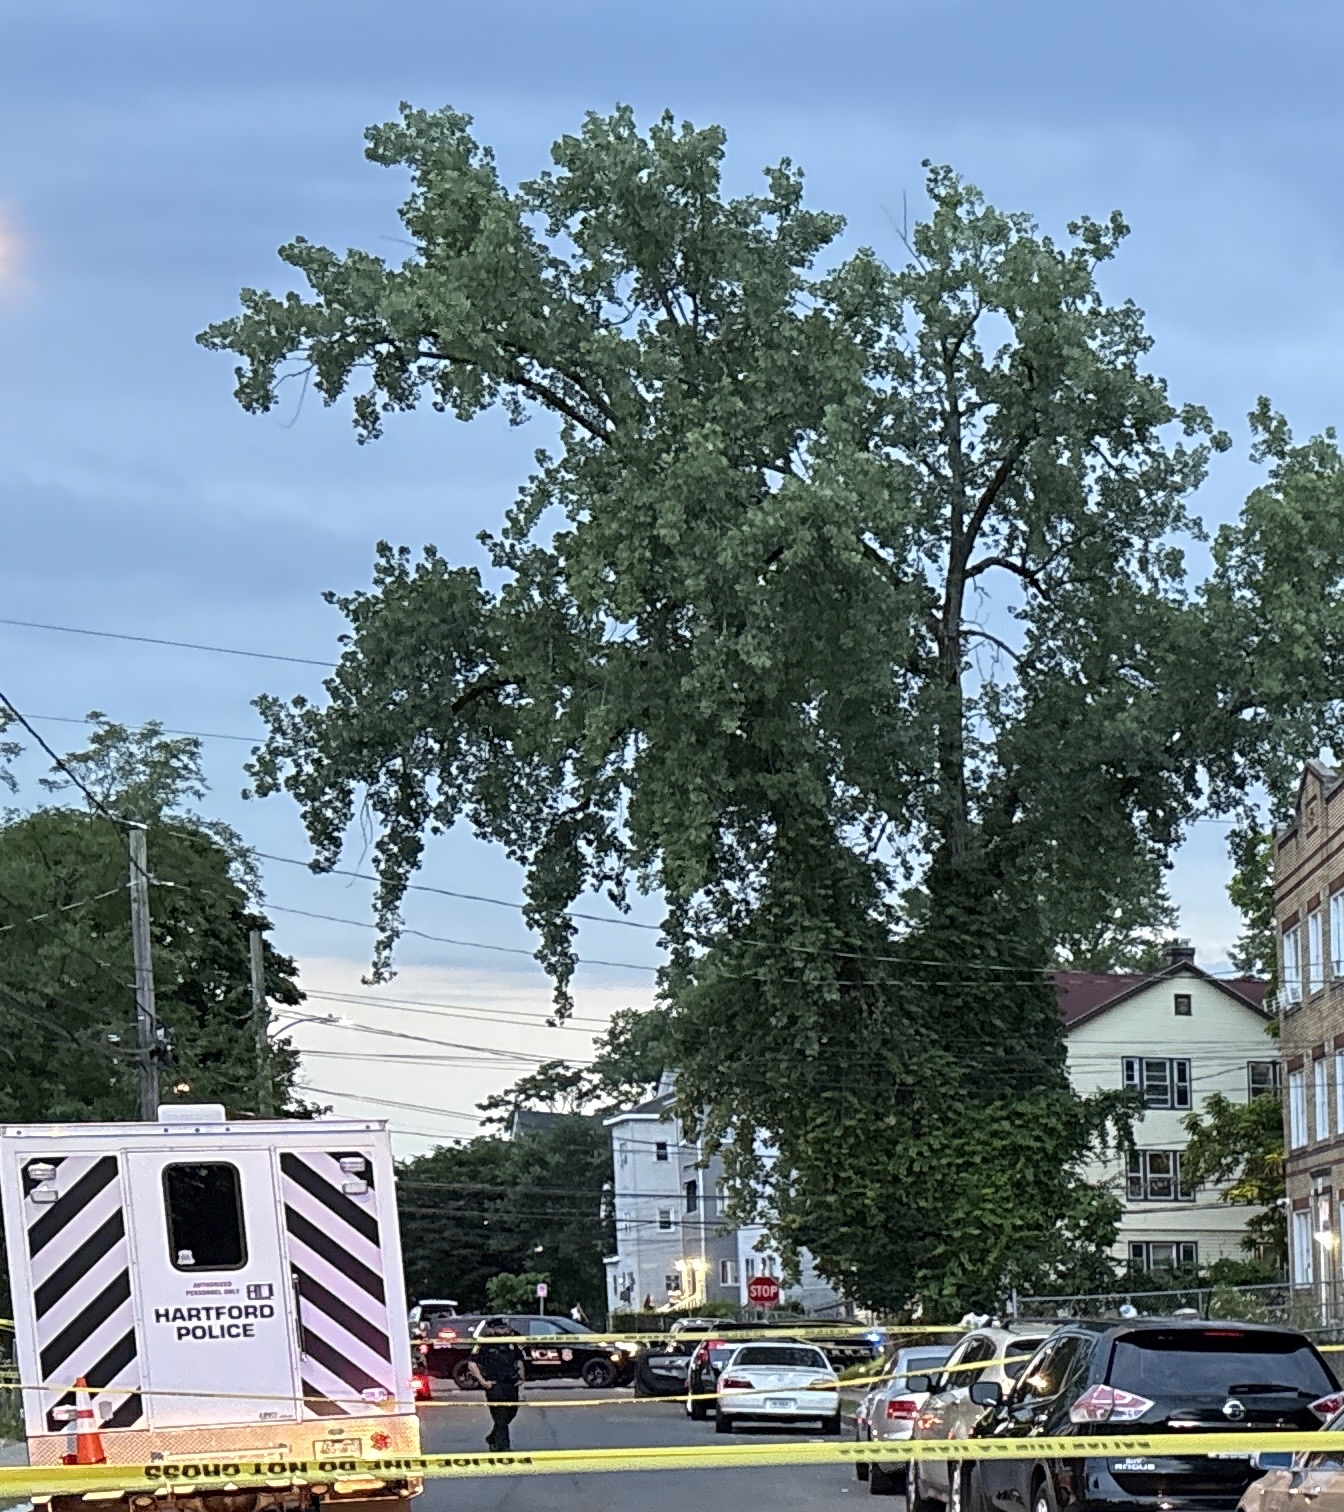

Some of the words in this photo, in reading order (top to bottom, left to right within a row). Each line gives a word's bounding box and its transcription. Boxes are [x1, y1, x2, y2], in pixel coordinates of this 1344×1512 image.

[750, 1285, 778, 1298] STOP
[154, 1304, 275, 1323] HARTFORD
[176, 1323, 255, 1341] POLICE
[144, 1462, 241, 1480] CROSS
[254, 1460, 308, 1475] NOT
[319, 1460, 357, 1472] DO
